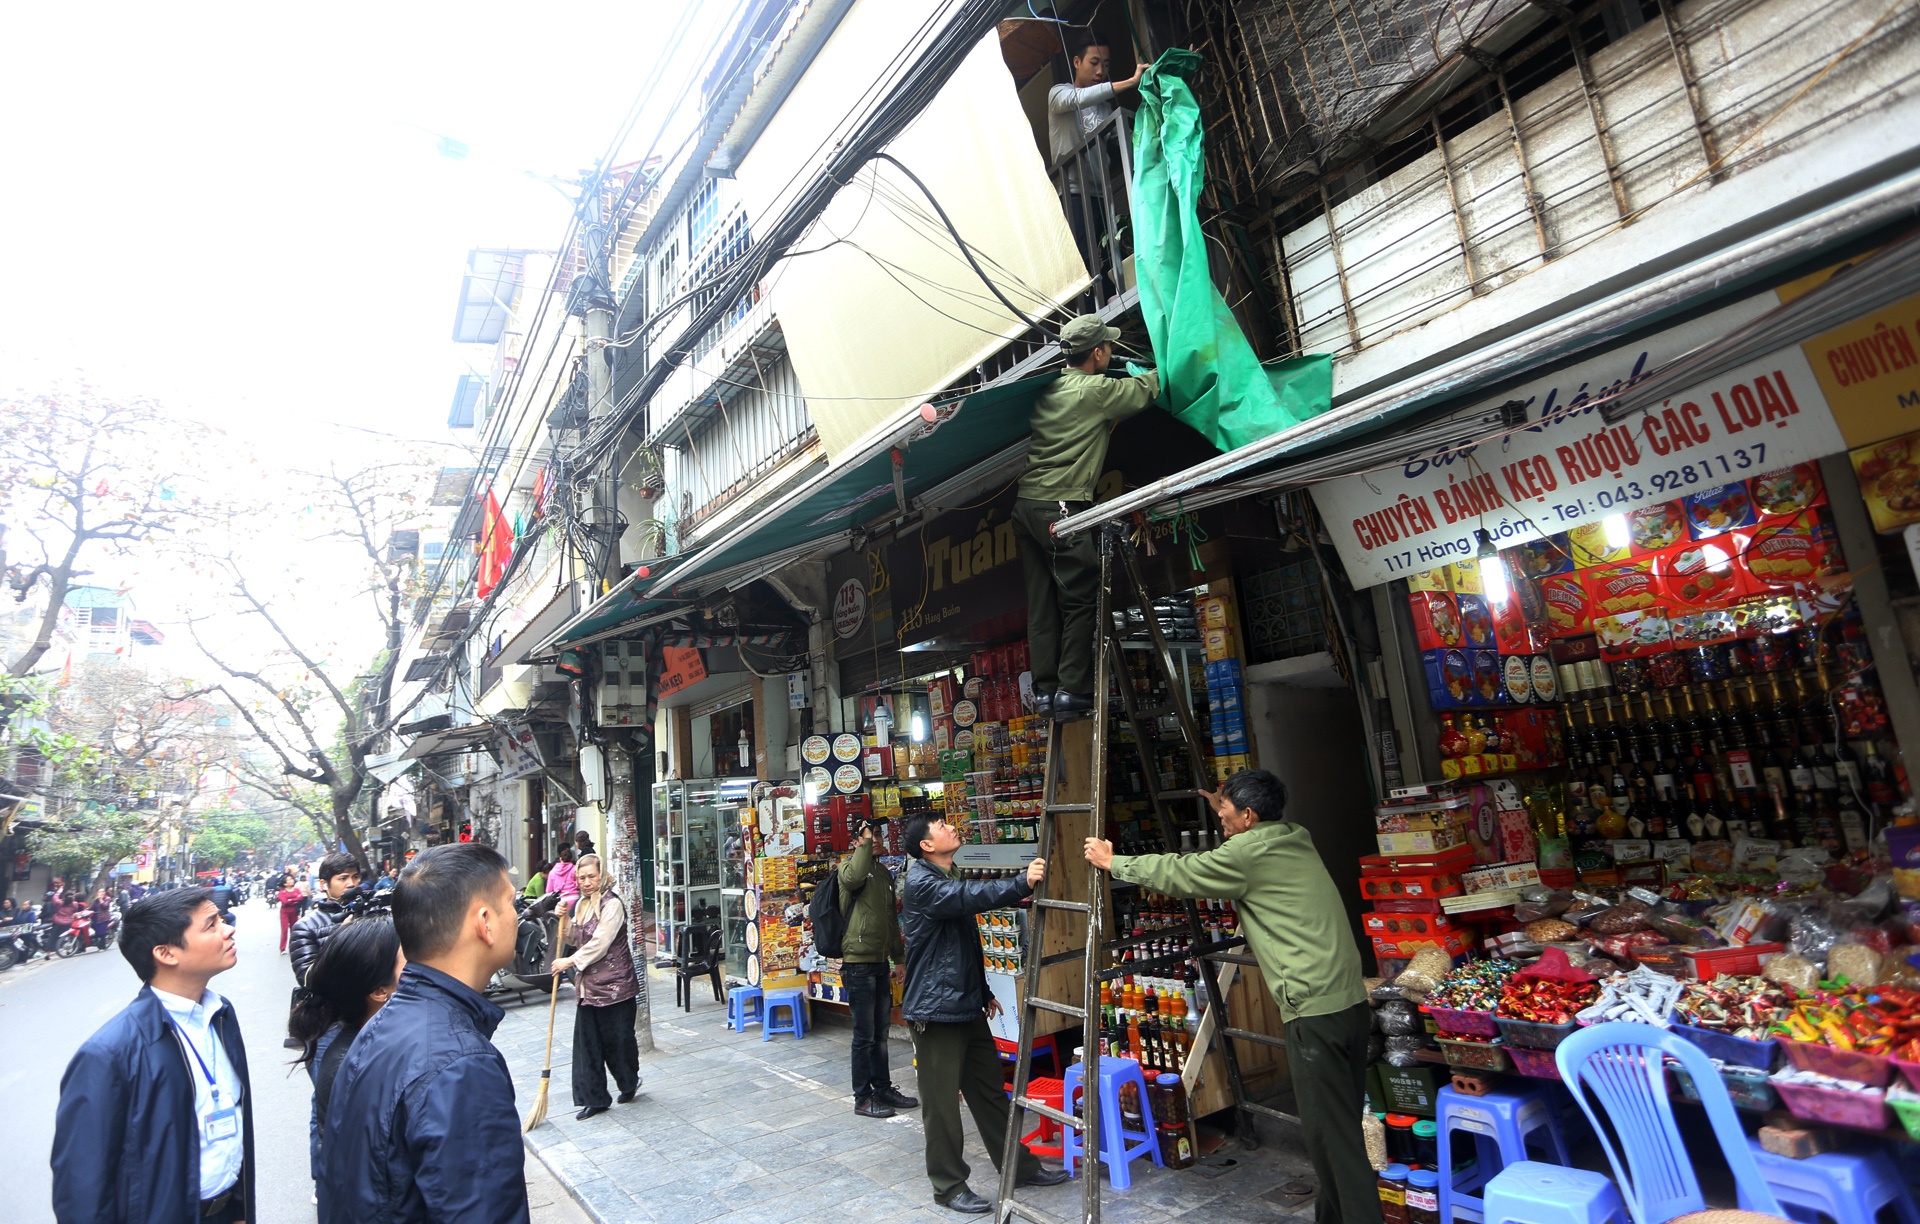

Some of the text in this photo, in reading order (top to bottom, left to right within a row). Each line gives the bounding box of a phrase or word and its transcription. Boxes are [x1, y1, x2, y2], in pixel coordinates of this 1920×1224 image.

[1826, 322, 1918, 388] CHUYÊN
[1352, 370, 1800, 551] CHUYÊN BÁNH KẸO RƯỢU CÁC LOẠI
[1384, 551, 1412, 573] 117
[1417, 534, 1472, 563] Hàng
[1597, 442, 1767, 509] 043.9281137
[840, 582, 855, 607] 113
[901, 603, 923, 633] 115
